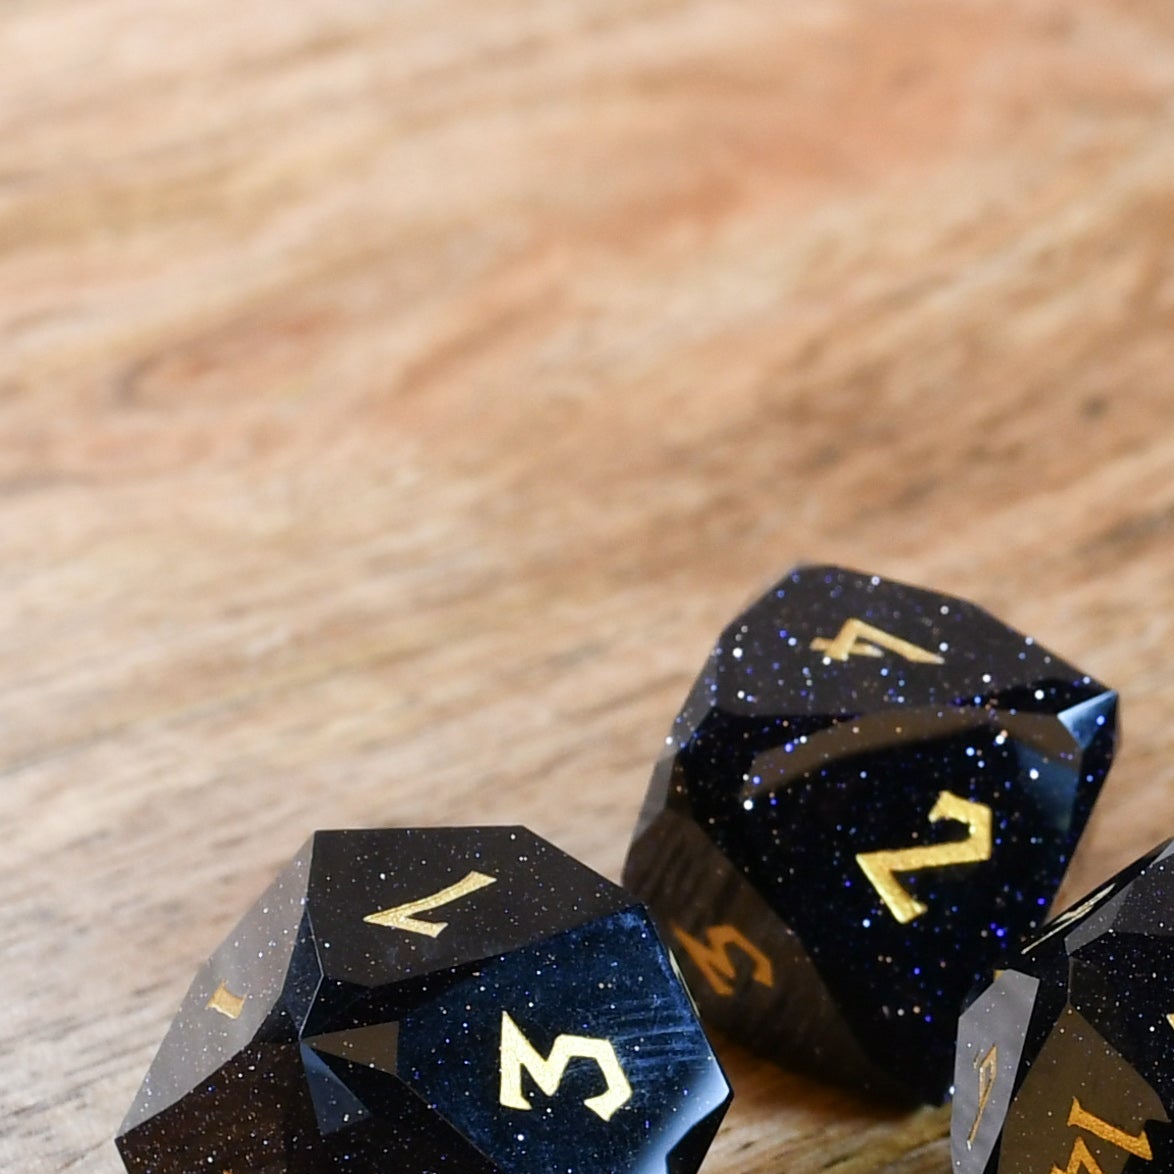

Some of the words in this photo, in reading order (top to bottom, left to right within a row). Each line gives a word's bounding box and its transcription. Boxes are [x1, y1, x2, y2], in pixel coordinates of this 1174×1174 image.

[810, 617, 946, 666] 4
[855, 790, 992, 924] 2
[363, 869, 498, 940] 7
[674, 923, 775, 997] 3
[499, 1010, 633, 1123] 3
